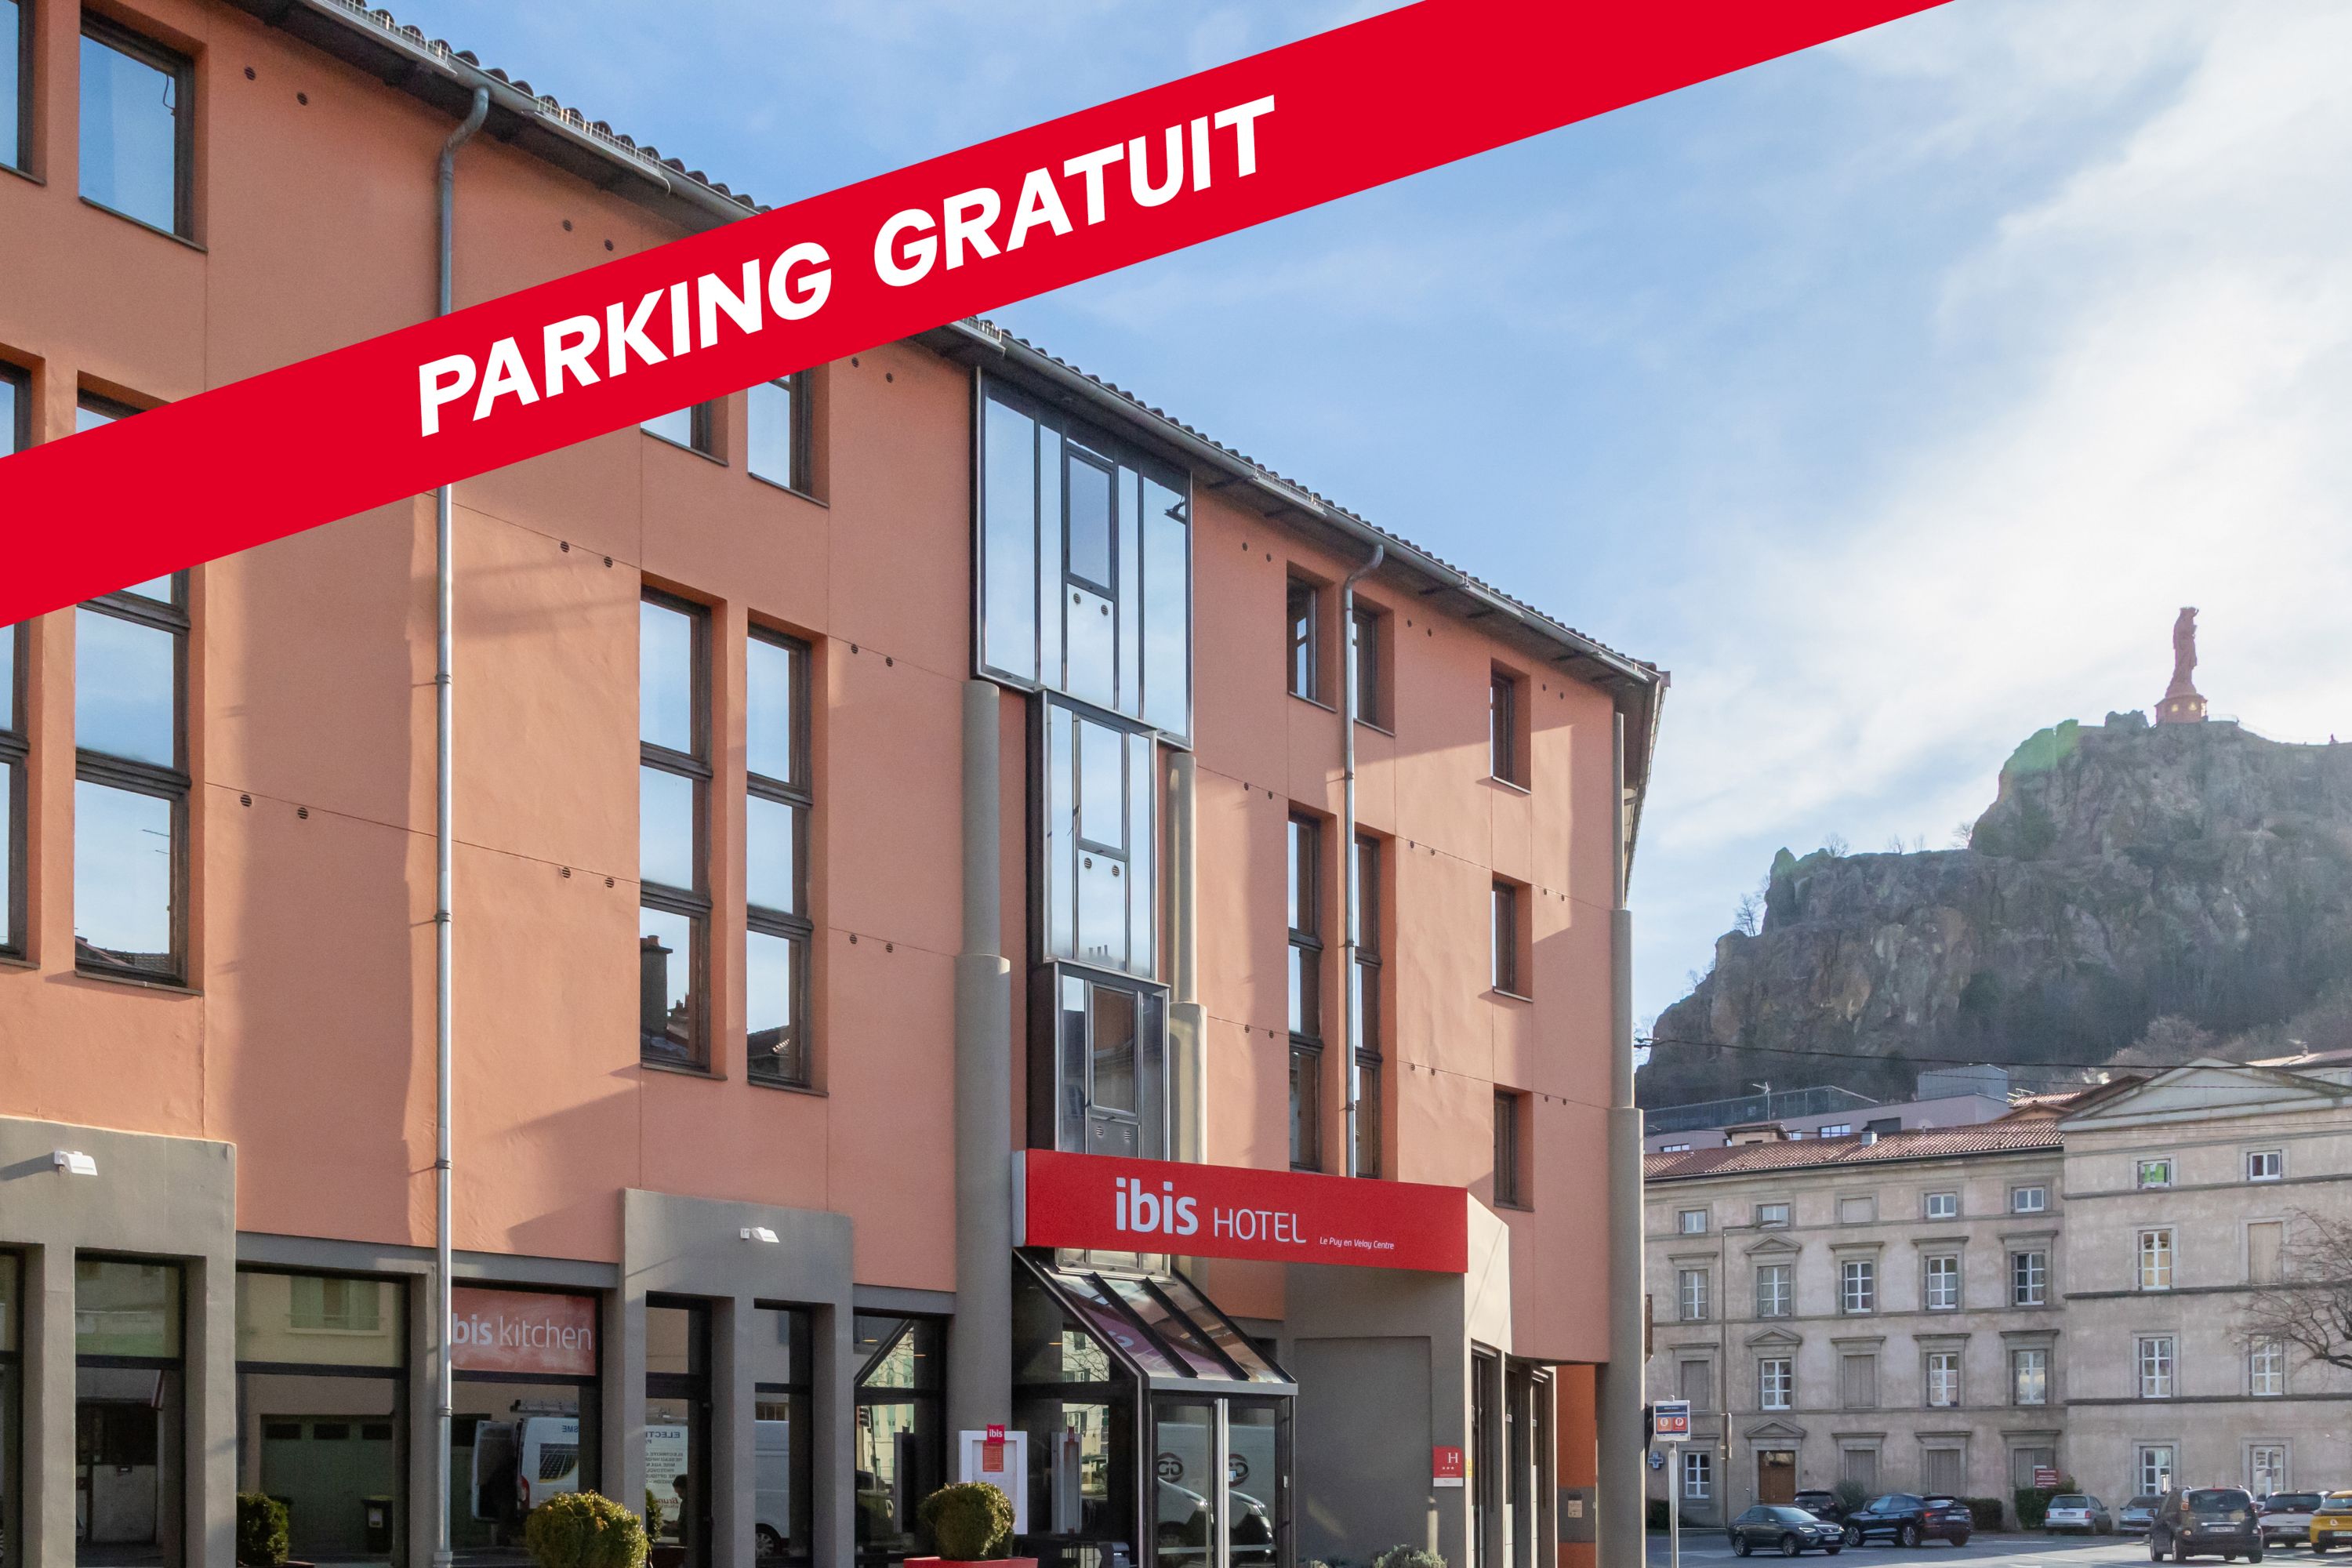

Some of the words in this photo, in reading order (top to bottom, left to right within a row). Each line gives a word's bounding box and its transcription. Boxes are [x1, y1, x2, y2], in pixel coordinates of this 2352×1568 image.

[1116, 1178, 1198, 1235] ibis
[1214, 1207, 1306, 1243] HOTEL
[1319, 1236, 1327, 1245] Le
[1329, 1237, 1341, 1247] Puy
[1354, 1239, 1372, 1250] Velay
[1373, 1240, 1395, 1250] Centre
[452, 1312, 493, 1345] bis
[499, 1316, 592, 1351] kitchen
[989, 1428, 1004, 1438] ibis
[1447, 1452, 1458, 1464] H
